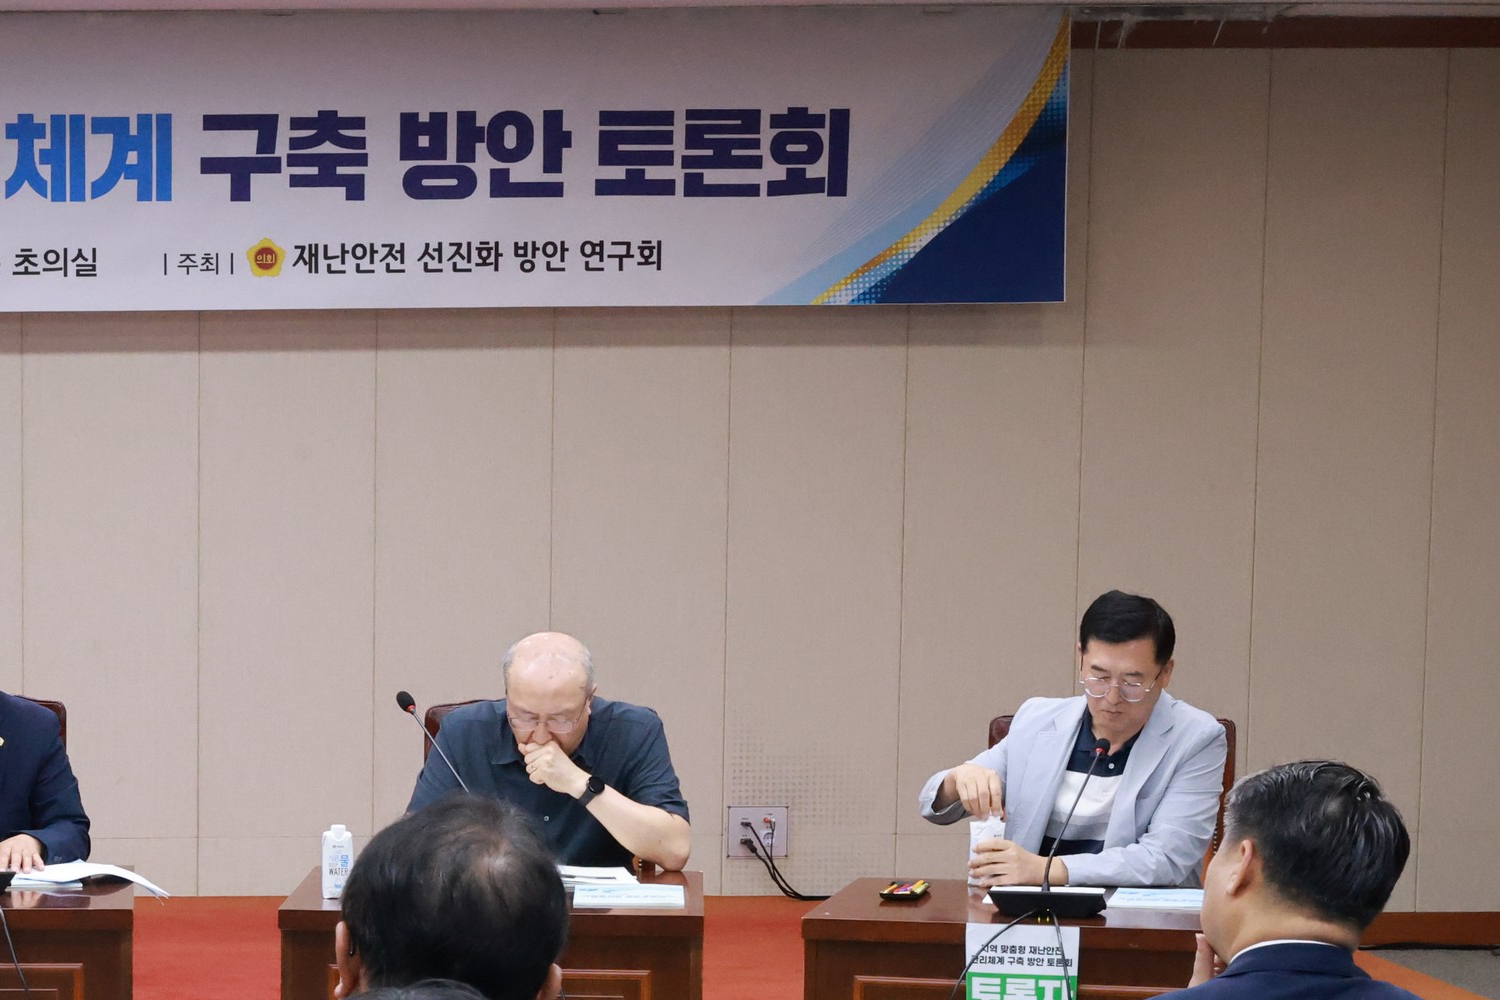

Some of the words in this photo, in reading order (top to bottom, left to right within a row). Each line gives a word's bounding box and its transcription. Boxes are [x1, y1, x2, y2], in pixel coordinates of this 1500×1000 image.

[201, 110, 368, 201] 구축
[400, 110, 572, 199] 방안
[595, 107, 850, 197] 토론회
[13, 248, 97, 277] 초의실
[178, 253, 218, 275] 주최
[293, 243, 405, 274] 재난안전
[417, 241, 503, 272] 선진화
[514, 241, 569, 273] 방안
[580, 240, 661, 271] 연구회
[1000, 944, 1026, 955] 맞춤형
[1007, 956, 1025, 966] 구축
[1027, 957, 1045, 967] 방안
